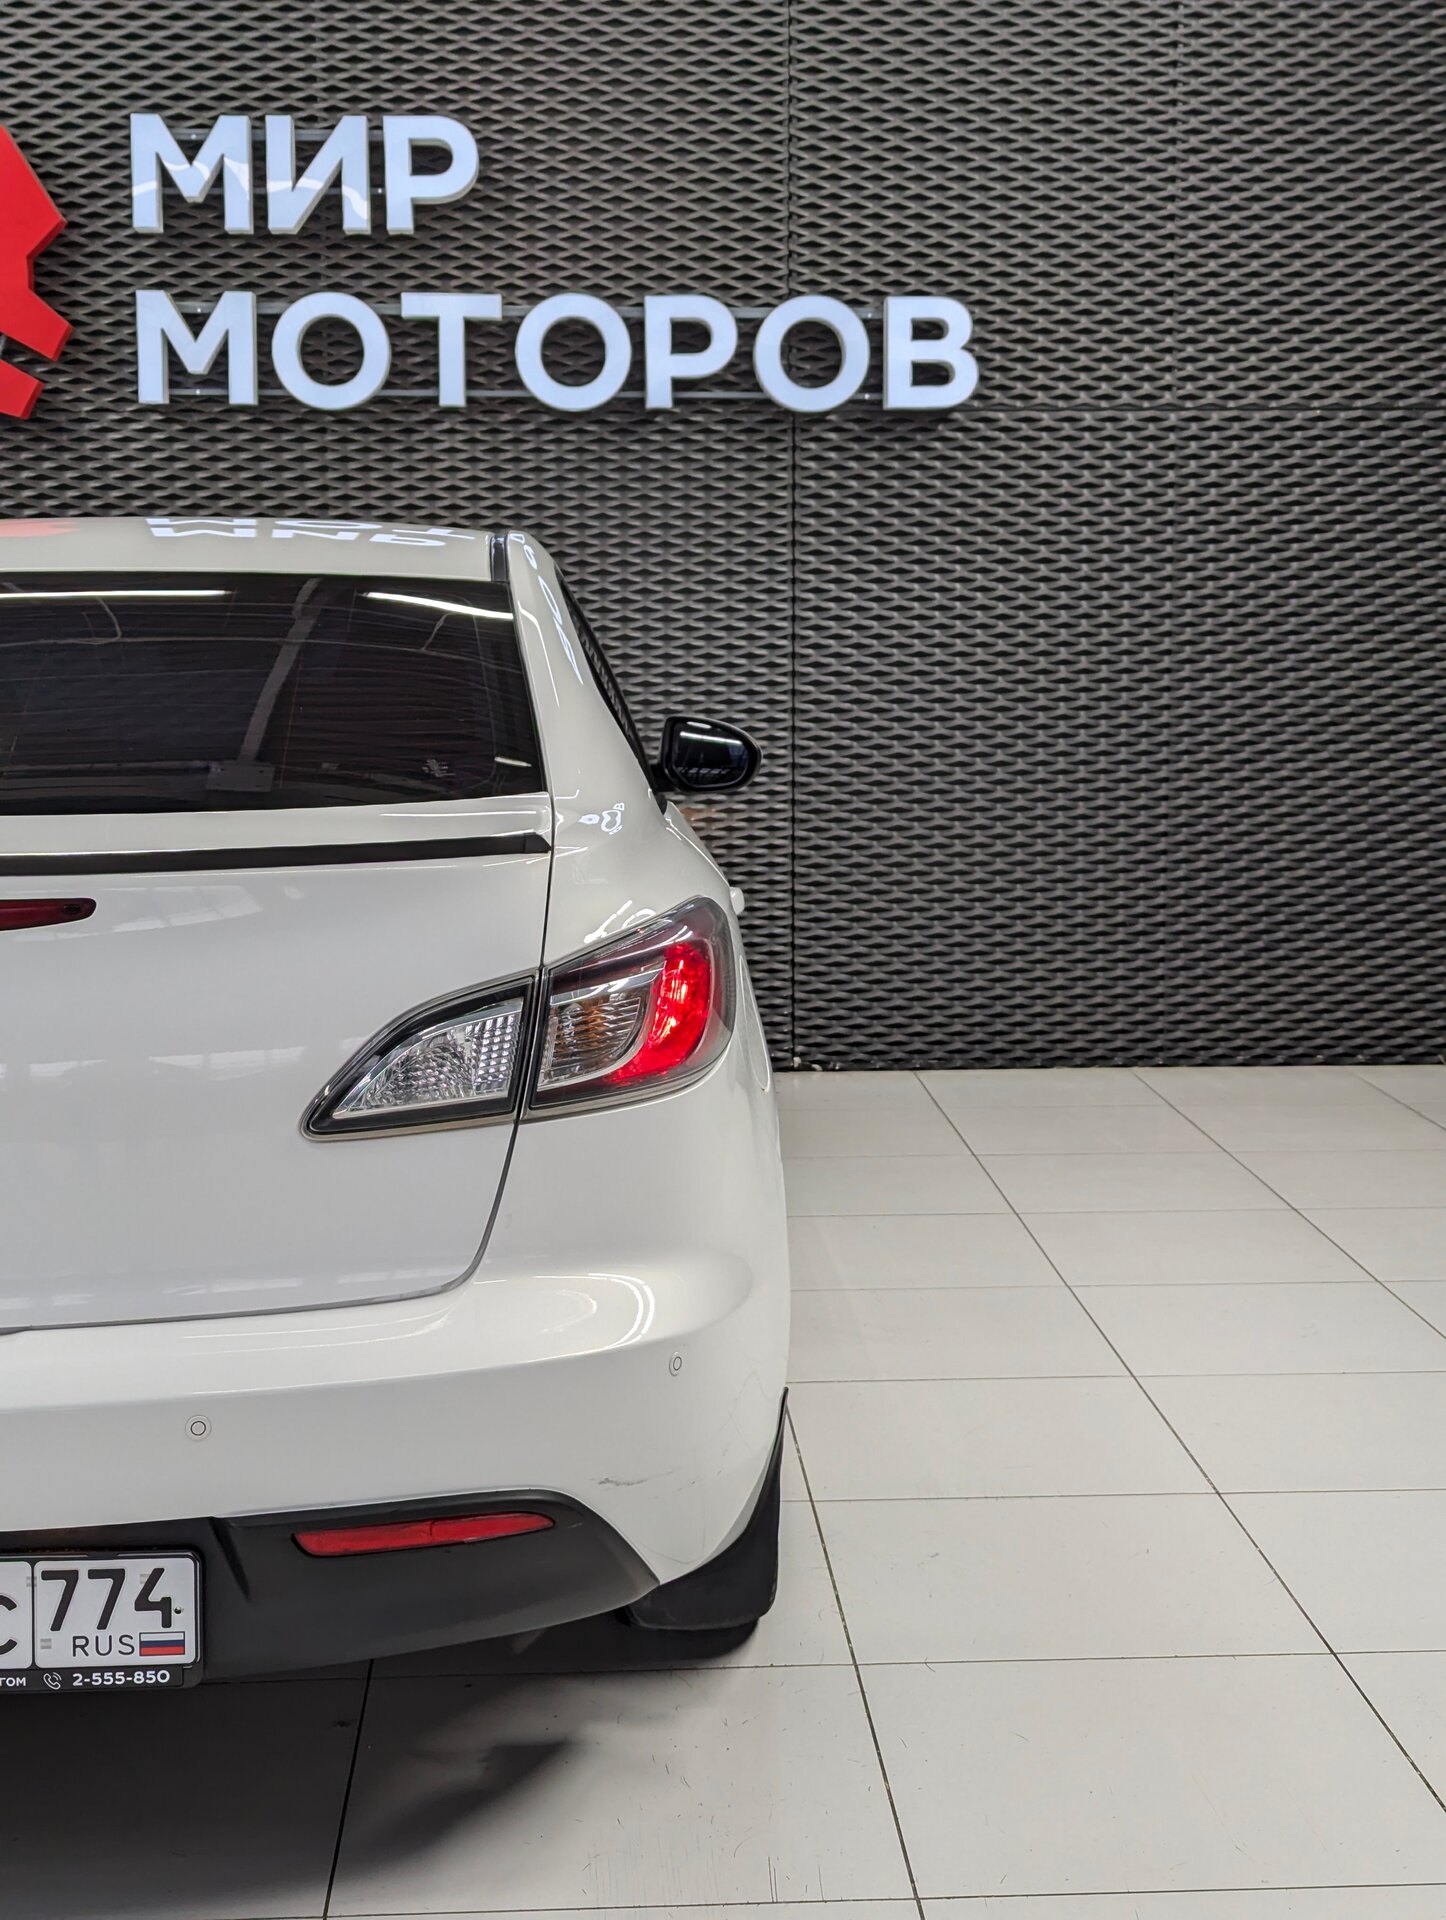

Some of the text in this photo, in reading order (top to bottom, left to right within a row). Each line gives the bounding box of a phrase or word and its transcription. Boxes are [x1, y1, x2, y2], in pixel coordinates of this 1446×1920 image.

[130, 113, 479, 235] МИР
[136, 290, 980, 412] МОТОРОВ
[41, 1567, 172, 1631] 774
[72, 1634, 135, 1657] RUS
[72, 1670, 170, 1686] 2-555-850
